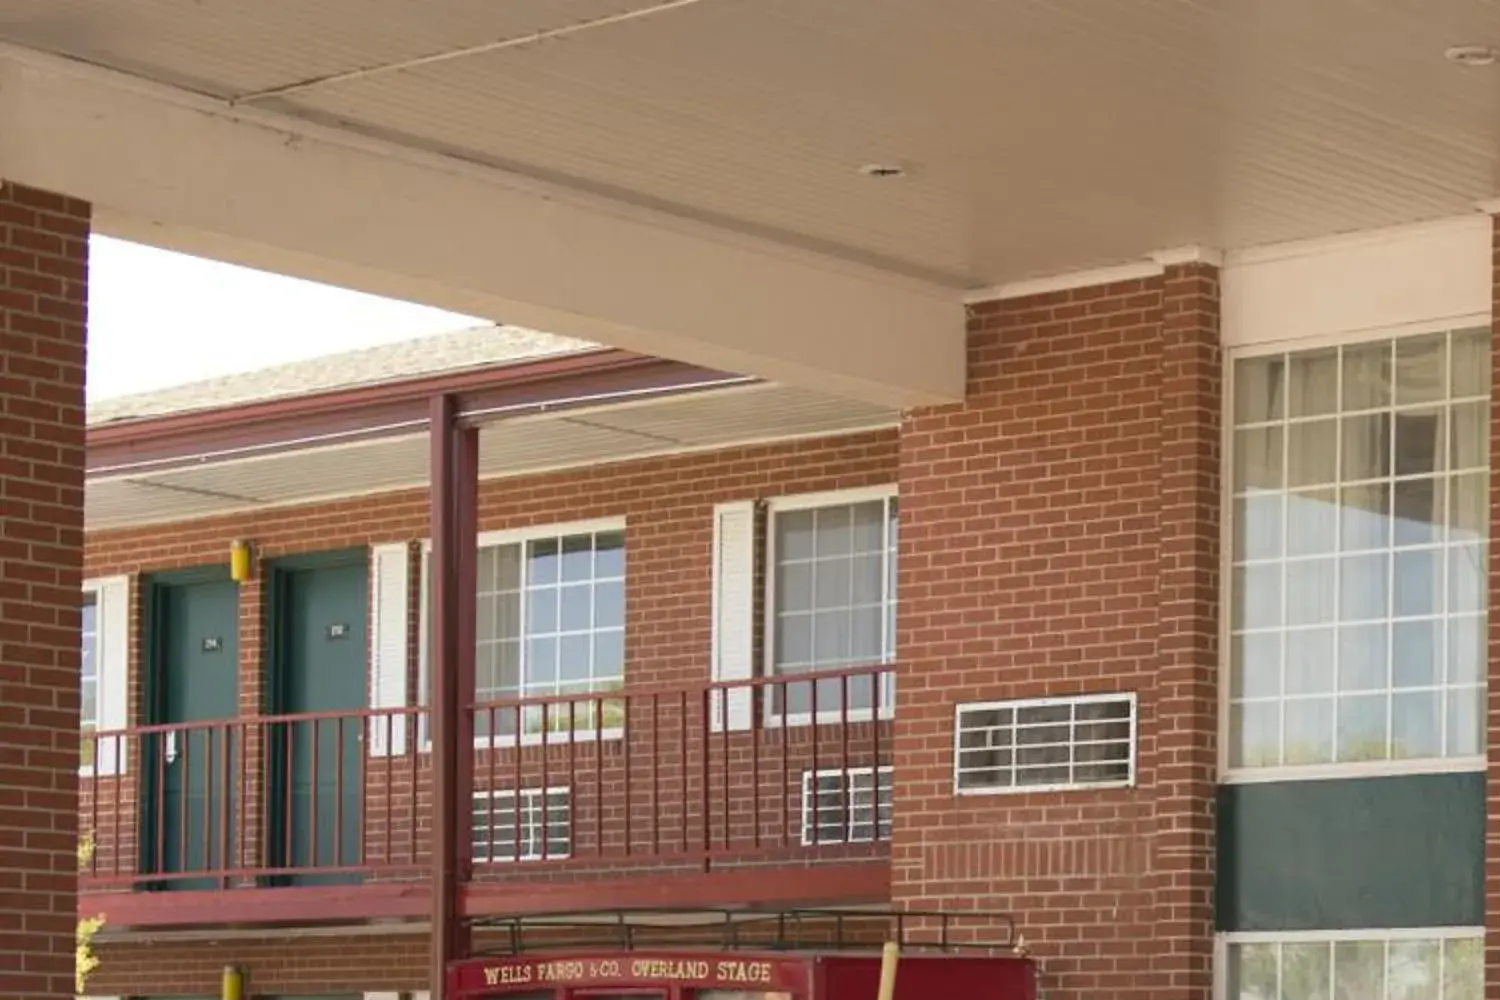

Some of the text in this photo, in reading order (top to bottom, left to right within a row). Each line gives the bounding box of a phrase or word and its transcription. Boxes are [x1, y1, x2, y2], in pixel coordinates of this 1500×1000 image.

[484, 965, 532, 985] WELLS
[537, 961, 584, 981] FARGO
[631, 959, 709, 979] OVERLAND
[716, 961, 771, 982] STAGE
